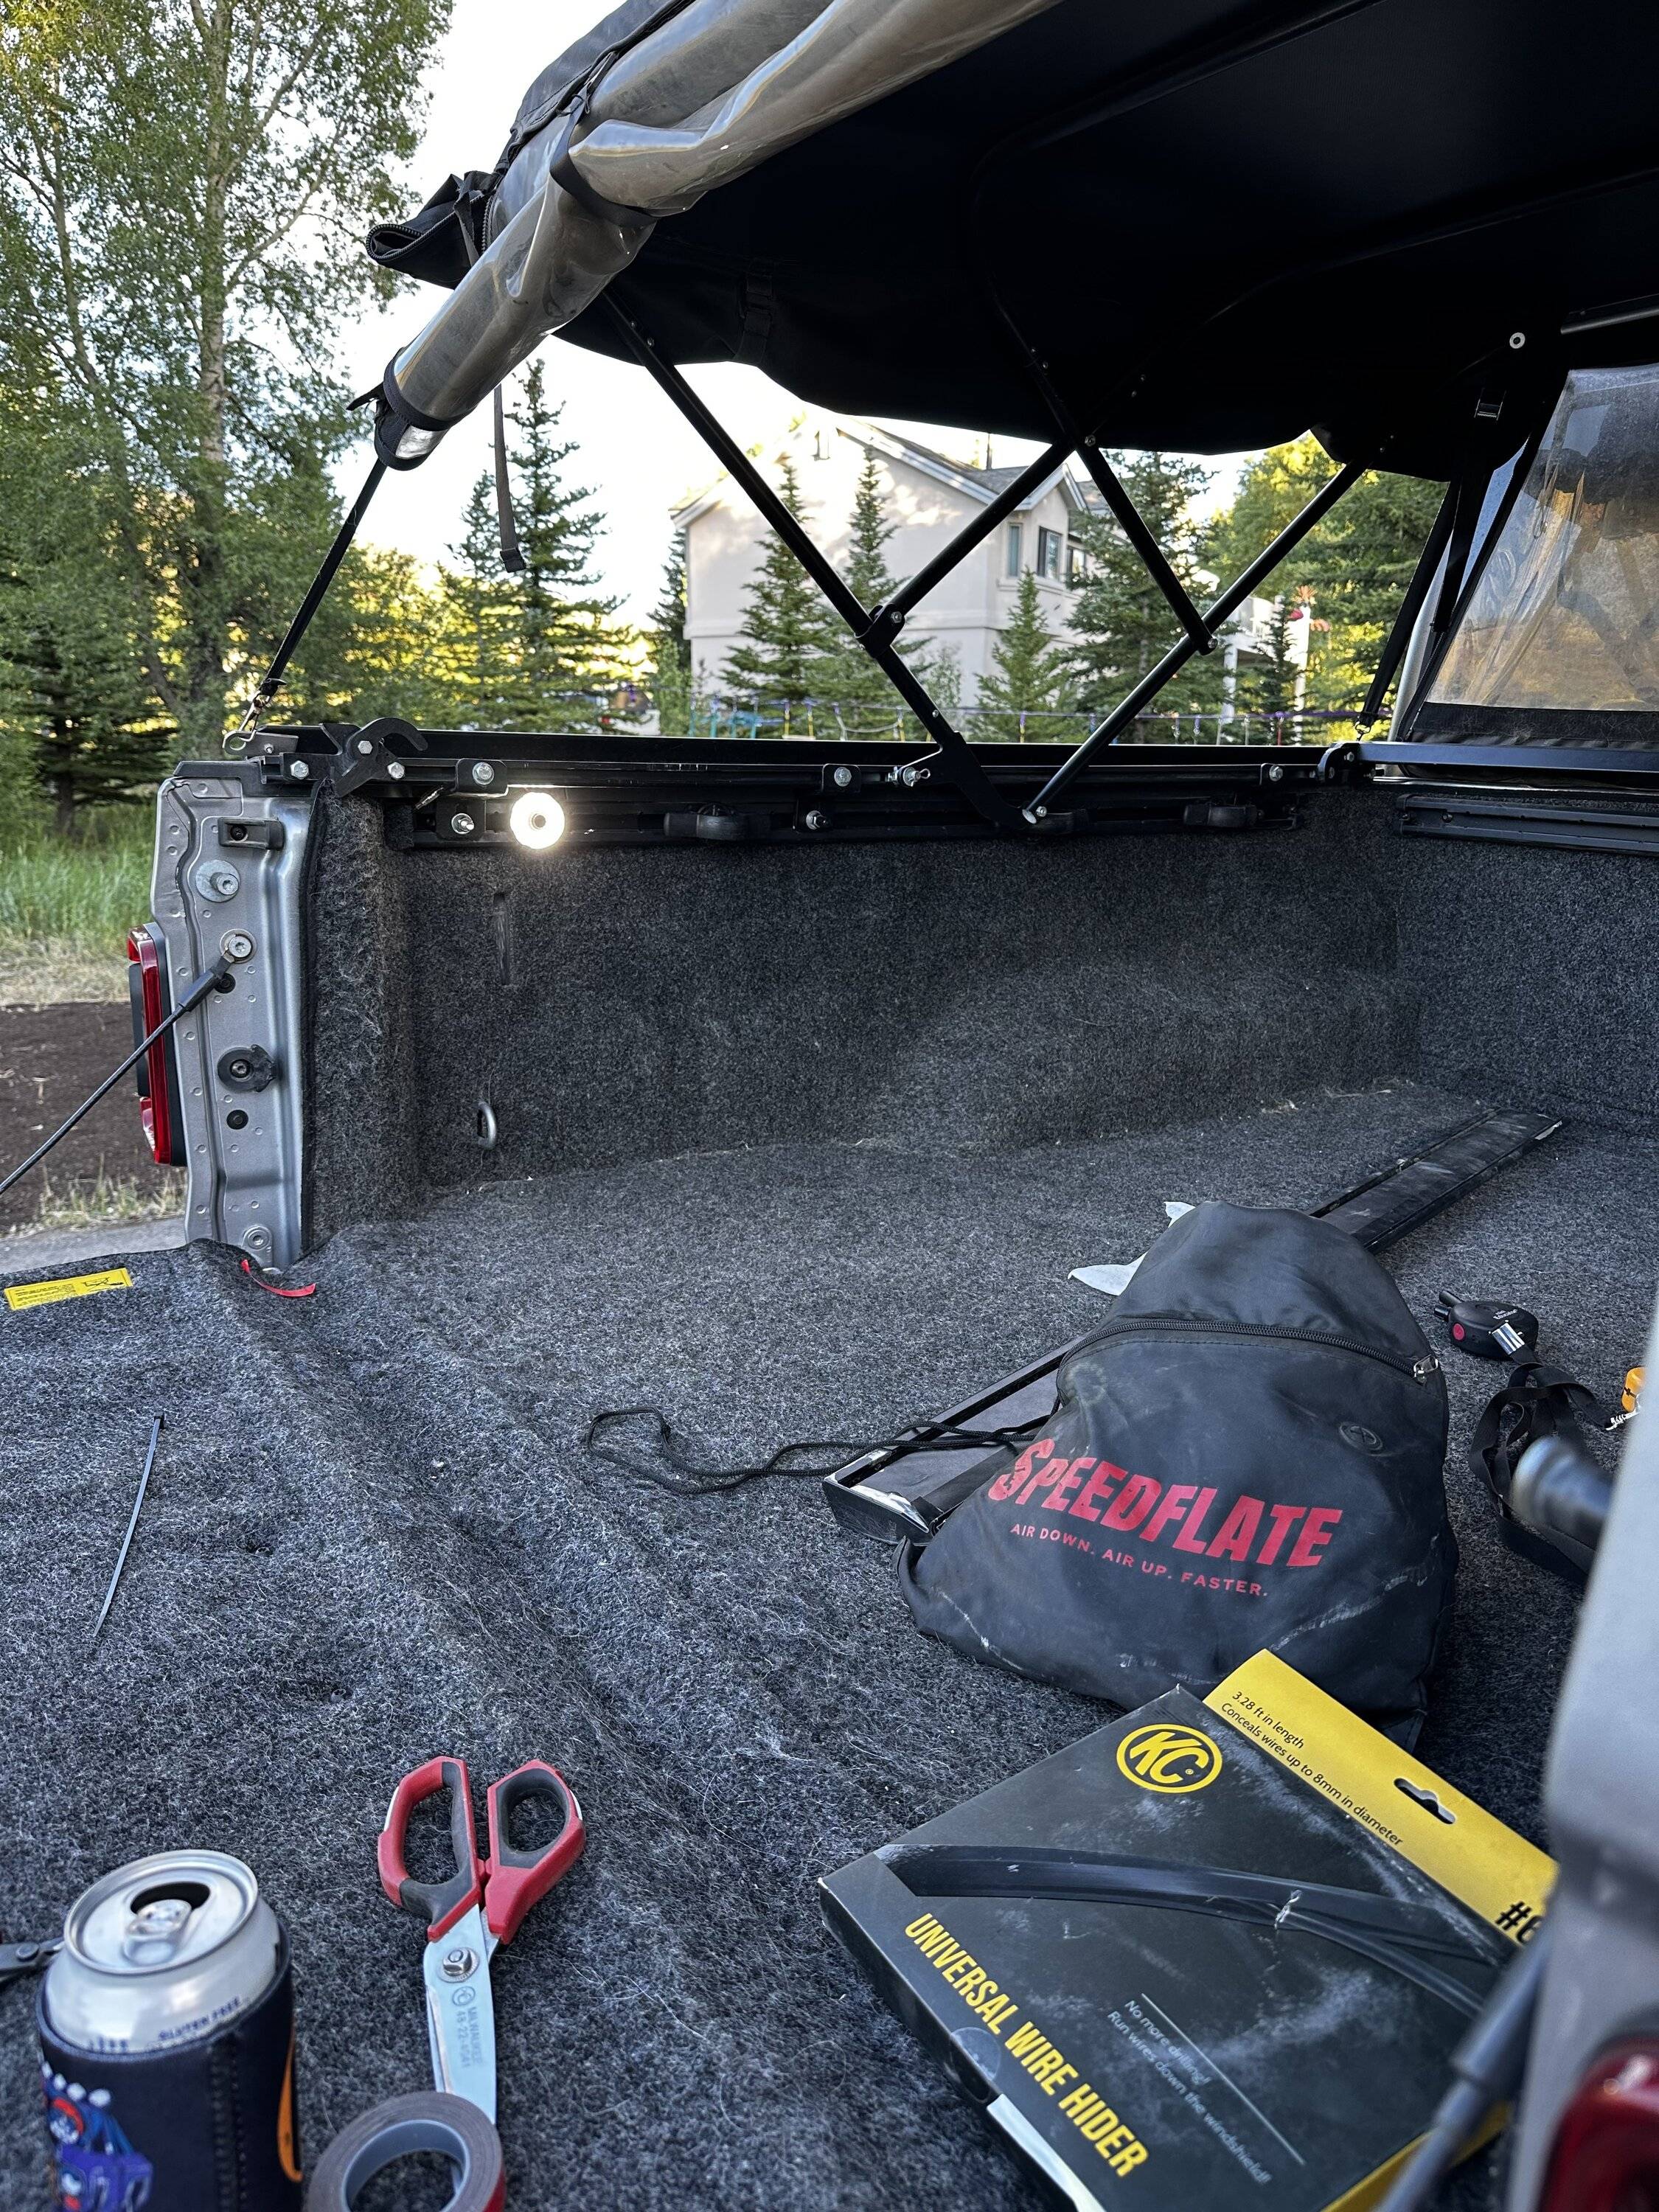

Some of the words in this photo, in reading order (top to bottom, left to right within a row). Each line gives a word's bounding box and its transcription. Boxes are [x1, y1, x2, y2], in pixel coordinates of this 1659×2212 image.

[988, 1438, 1343, 1567] SPEEDFLATE
[1010, 1523, 1035, 1537] AIR
[1040, 1528, 1094, 1554] DOWN.
[1102, 1549, 1133, 1567] AIR
[1141, 1561, 1172, 1579] UP.
[1181, 1572, 1267, 1596] FASTER.
[1129, 1731, 1210, 1784] KC
[1232, 1691, 1256, 1710] 3.28
[1253, 1707, 1266, 1718] ft
[1262, 1714, 1274, 1725] in
[1273, 1722, 1304, 1748] length
[1221, 1703, 1262, 1737] Conceals
[1261, 1733, 1286, 1756] wires
[1286, 1754, 1301, 1767] up
[1301, 1764, 1312, 1776] to
[1313, 1773, 1342, 1800] 8mm
[1341, 1795, 1353, 1808] in
[1354, 1806, 1403, 1846] diameter
[905, 1913, 1019, 2035] UNIVERSAL
[1004, 2020, 1079, 2096] WIRE
[1057, 2083, 1149, 2177] HIDER
[1107, 2010, 1130, 2035] Run
[1128, 2033, 1156, 2062] wires
[1155, 2062, 1186, 2095] down
[1184, 2092, 1206, 2114] the
[1124, 2000, 1142, 2019] No
[1140, 2017, 1170, 2046] more
